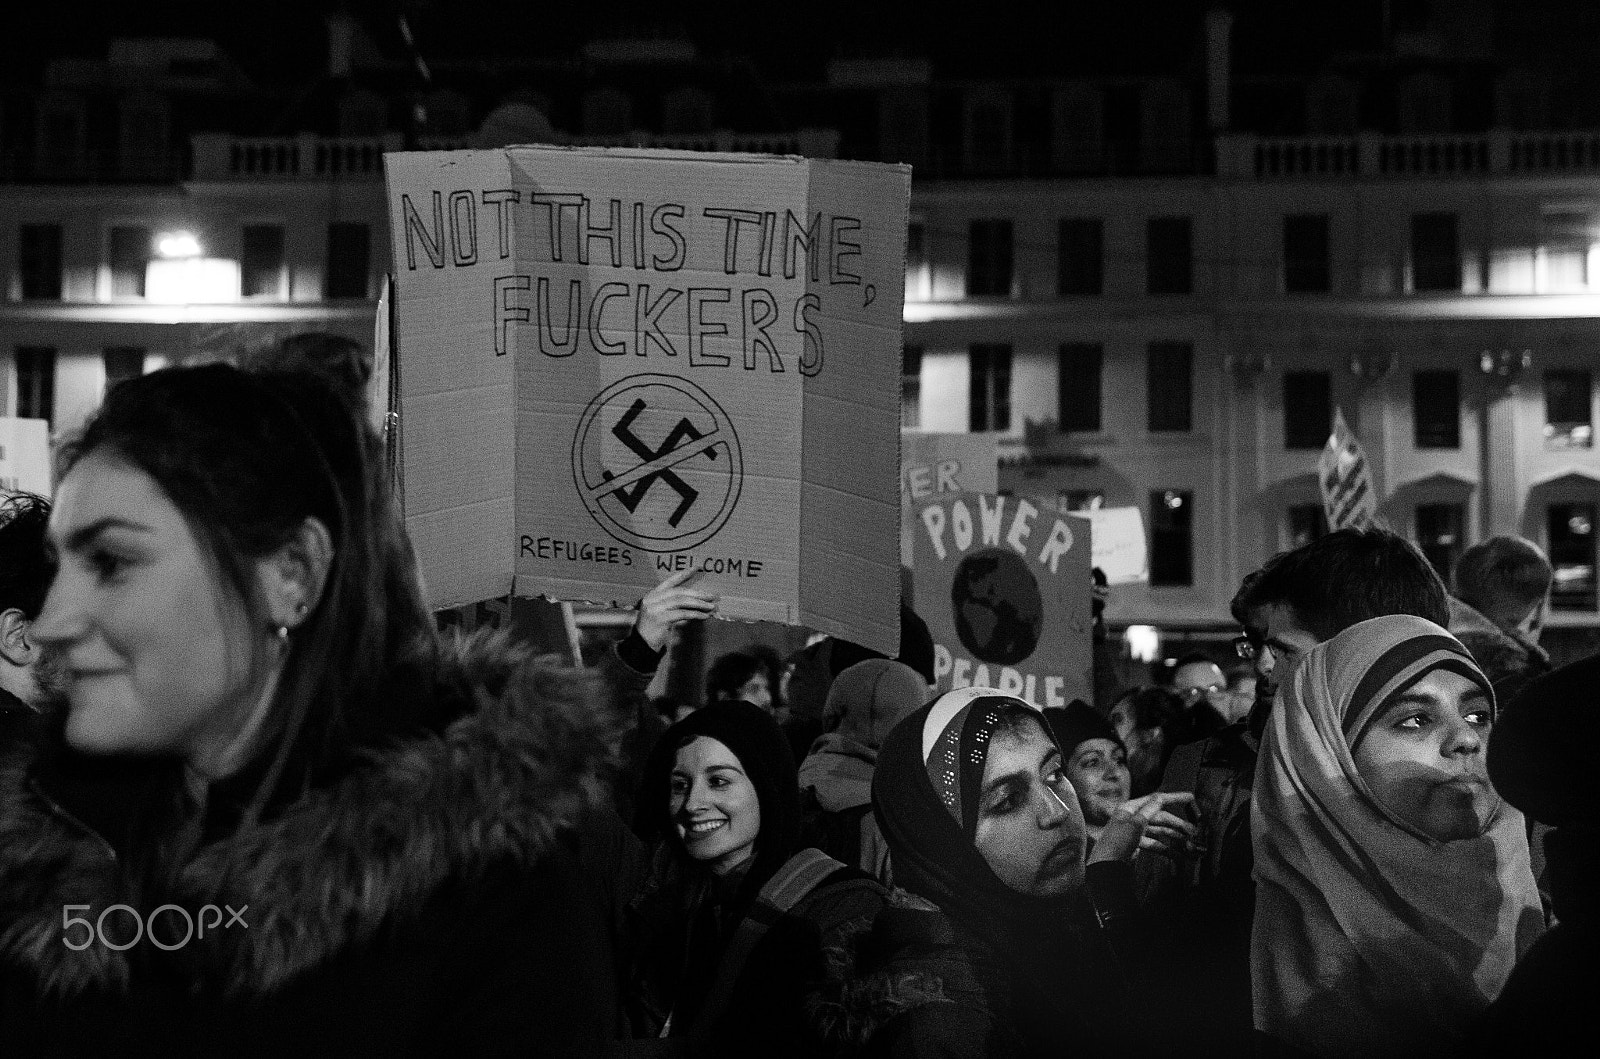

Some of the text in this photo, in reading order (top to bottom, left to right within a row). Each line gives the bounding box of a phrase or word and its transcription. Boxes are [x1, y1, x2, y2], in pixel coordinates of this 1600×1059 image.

[402, 189, 877, 308] NOT THIS TIME,
[493, 275, 824, 377] FUCKERS
[520, 535, 633, 566] REFUGEES
[921, 494, 1074, 574] POWER
